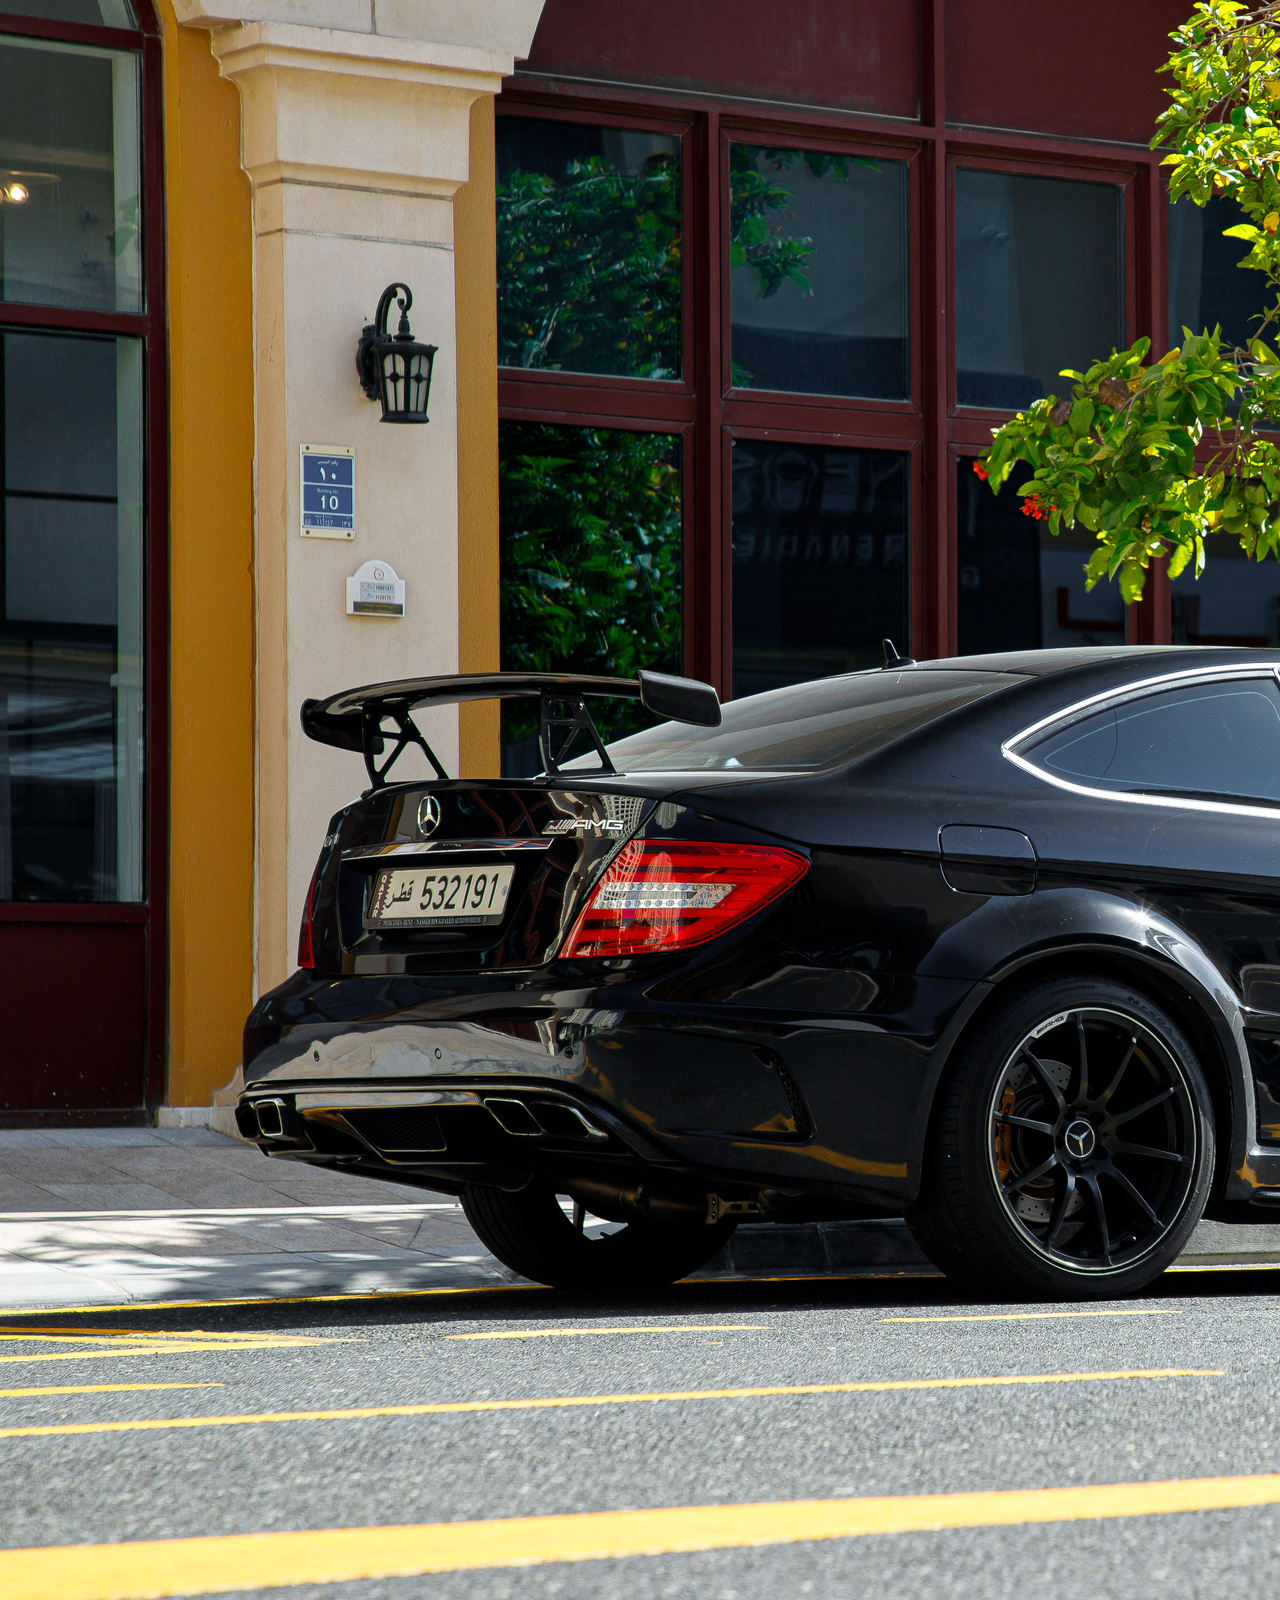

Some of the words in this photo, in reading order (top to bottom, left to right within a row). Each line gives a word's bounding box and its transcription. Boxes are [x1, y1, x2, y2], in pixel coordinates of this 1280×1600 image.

[319, 466, 337, 482] ١٠
[320, 494, 338, 510] 10
[570, 819, 624, 831] AMG
[371, 874, 387, 918] QATAR
[384, 879, 415, 909] قطر
[419, 872, 500, 911] 532191
